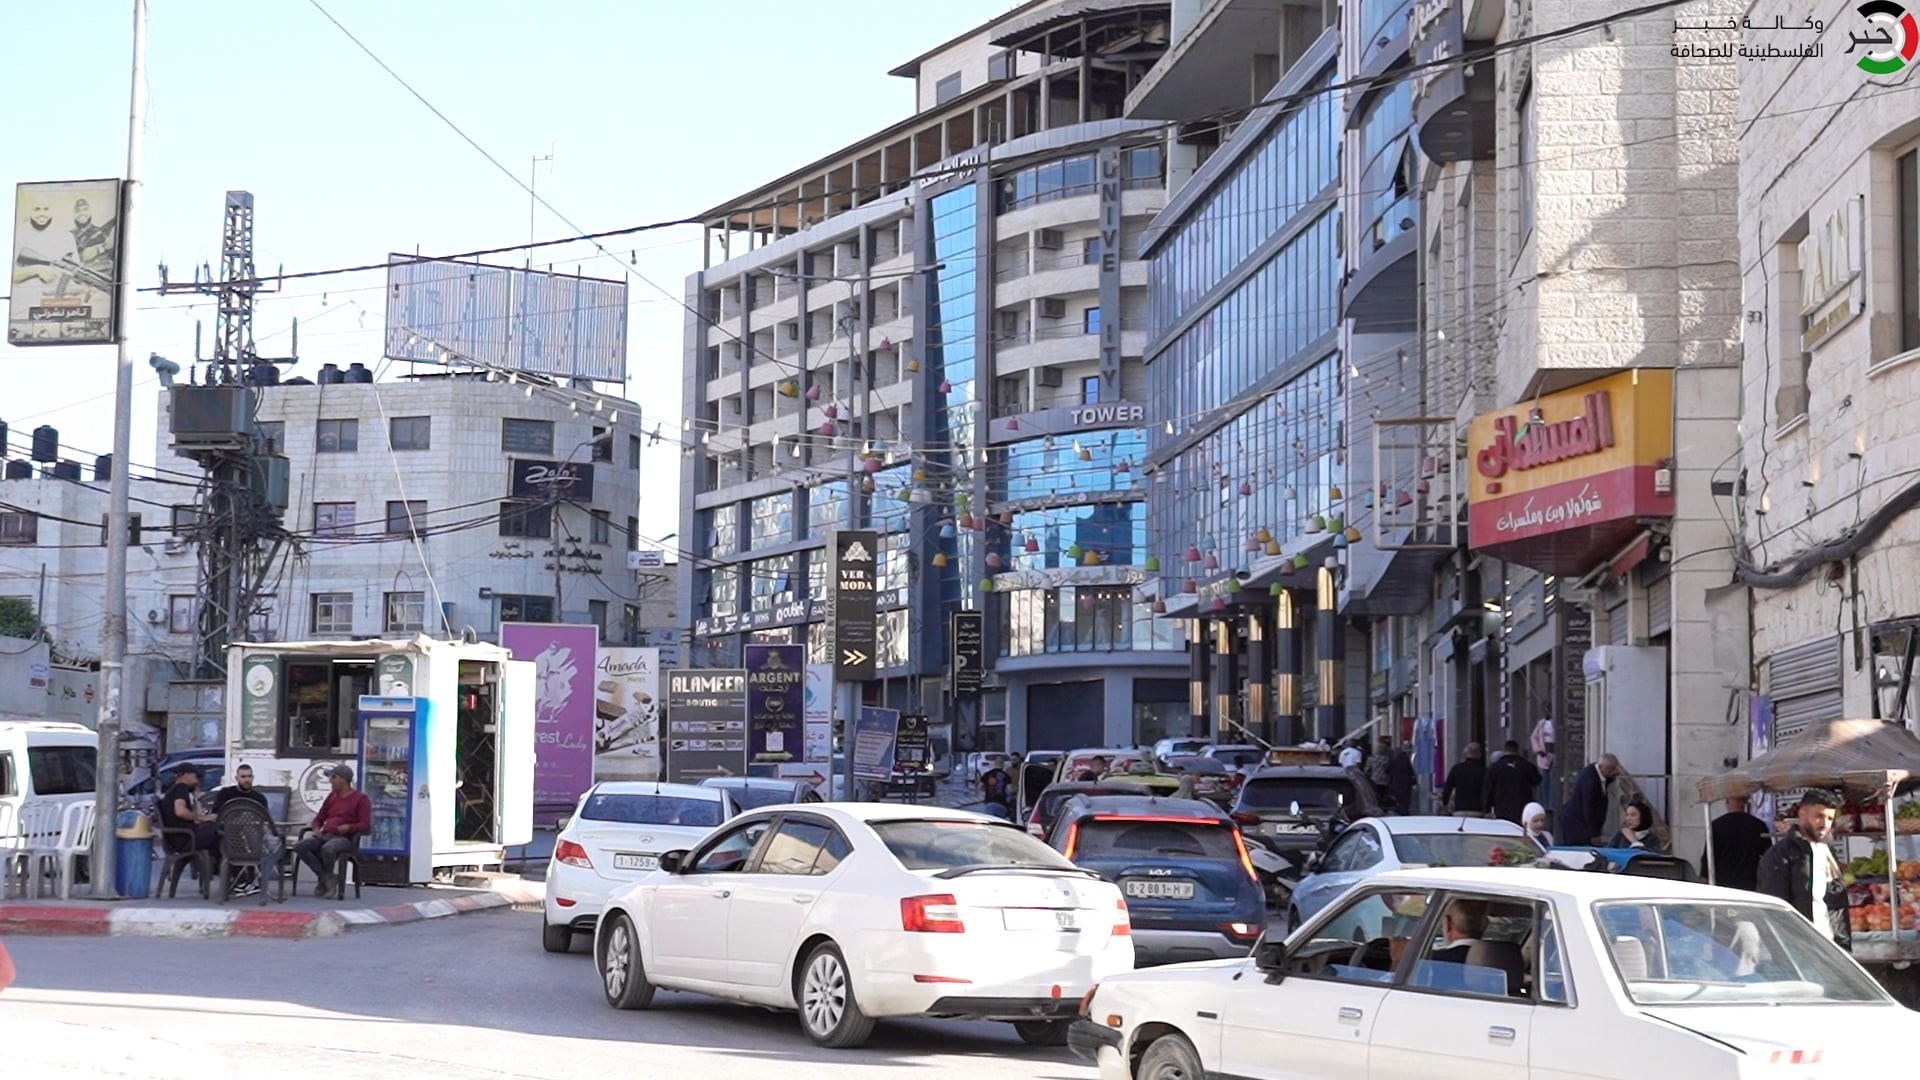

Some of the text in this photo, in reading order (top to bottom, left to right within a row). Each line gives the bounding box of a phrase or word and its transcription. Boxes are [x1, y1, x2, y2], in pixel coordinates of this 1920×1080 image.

[1071, 406, 1144, 425] TOWER
[840, 581, 873, 591] MODA
[597, 655, 648, 673] Amada
[672, 676, 744, 693] ALAMEER
[750, 672, 800, 683] ARGENT
